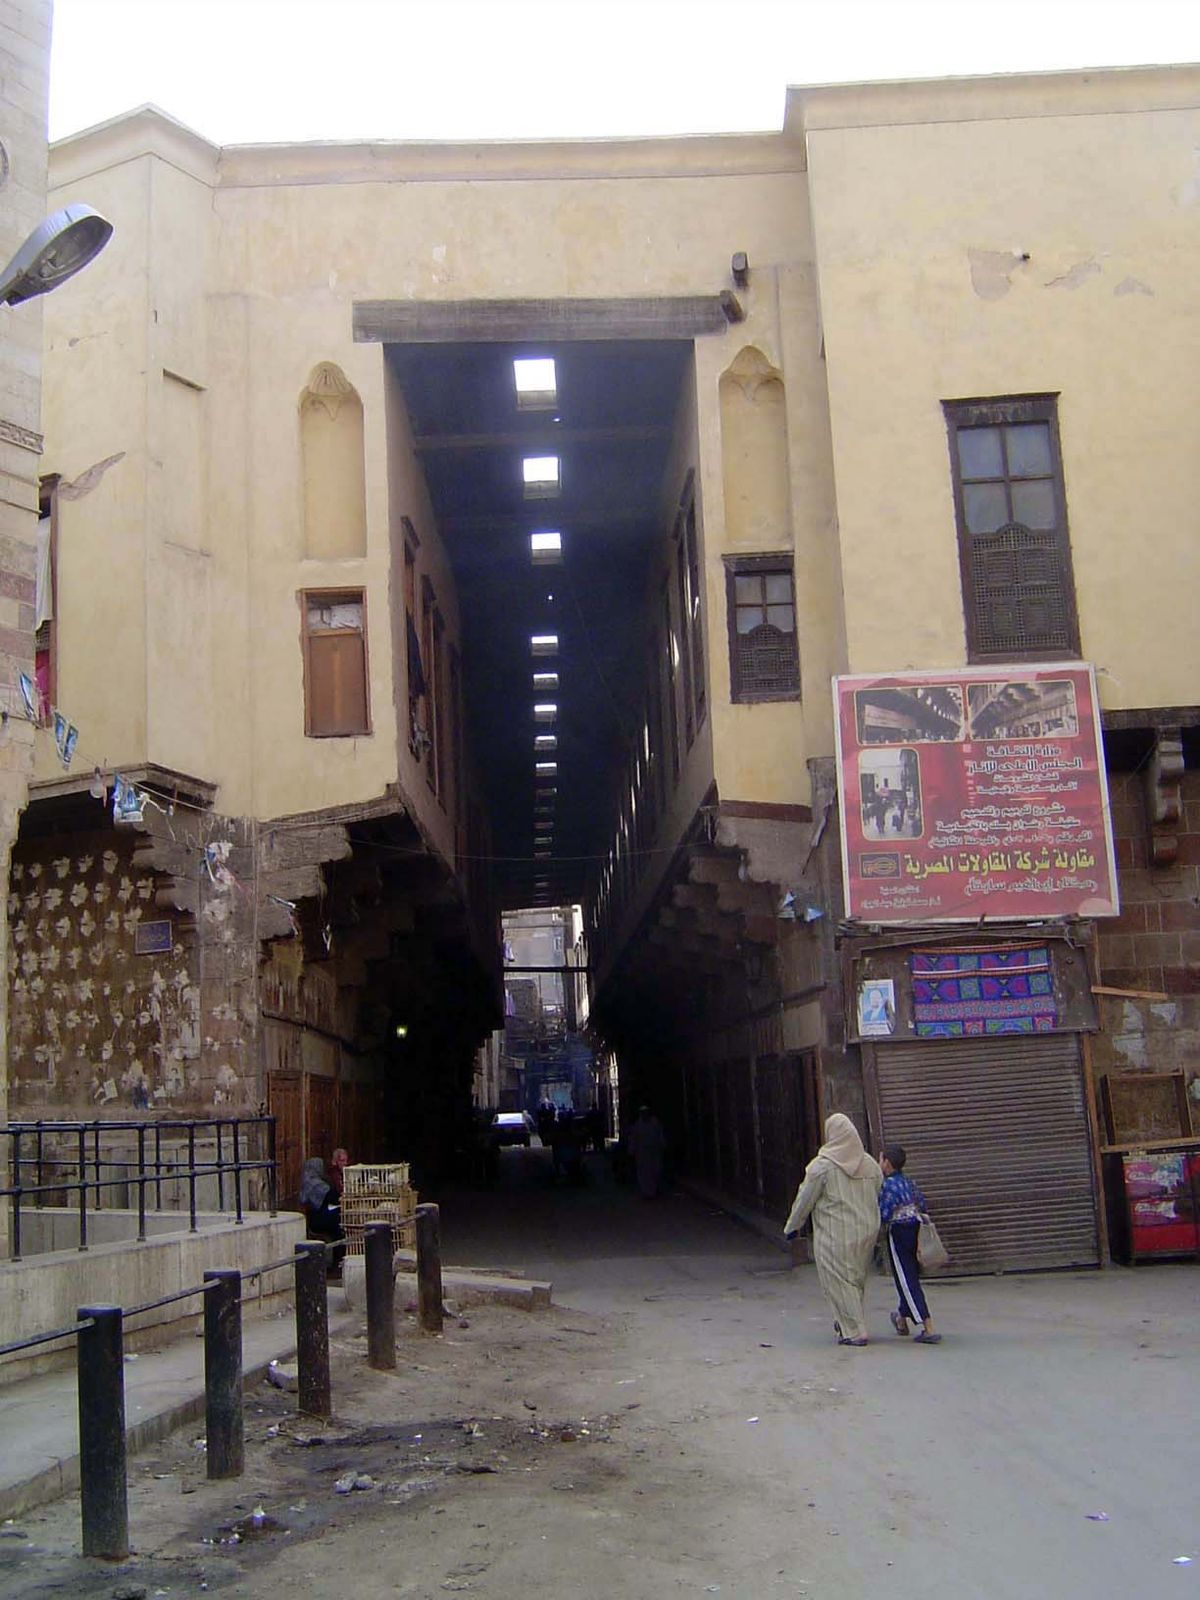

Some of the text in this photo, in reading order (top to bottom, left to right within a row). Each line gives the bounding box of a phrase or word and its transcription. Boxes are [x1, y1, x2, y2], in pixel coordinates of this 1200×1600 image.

[986, 743, 1062, 758] وزارة الثقافة
[1039, 757, 1083, 772] المجلس
[1001, 805, 1032, 819] ترميم
[1033, 802, 1065, 816] مشروع
[904, 846, 1094, 880] مقاولة شركة المقاولات المصرية
